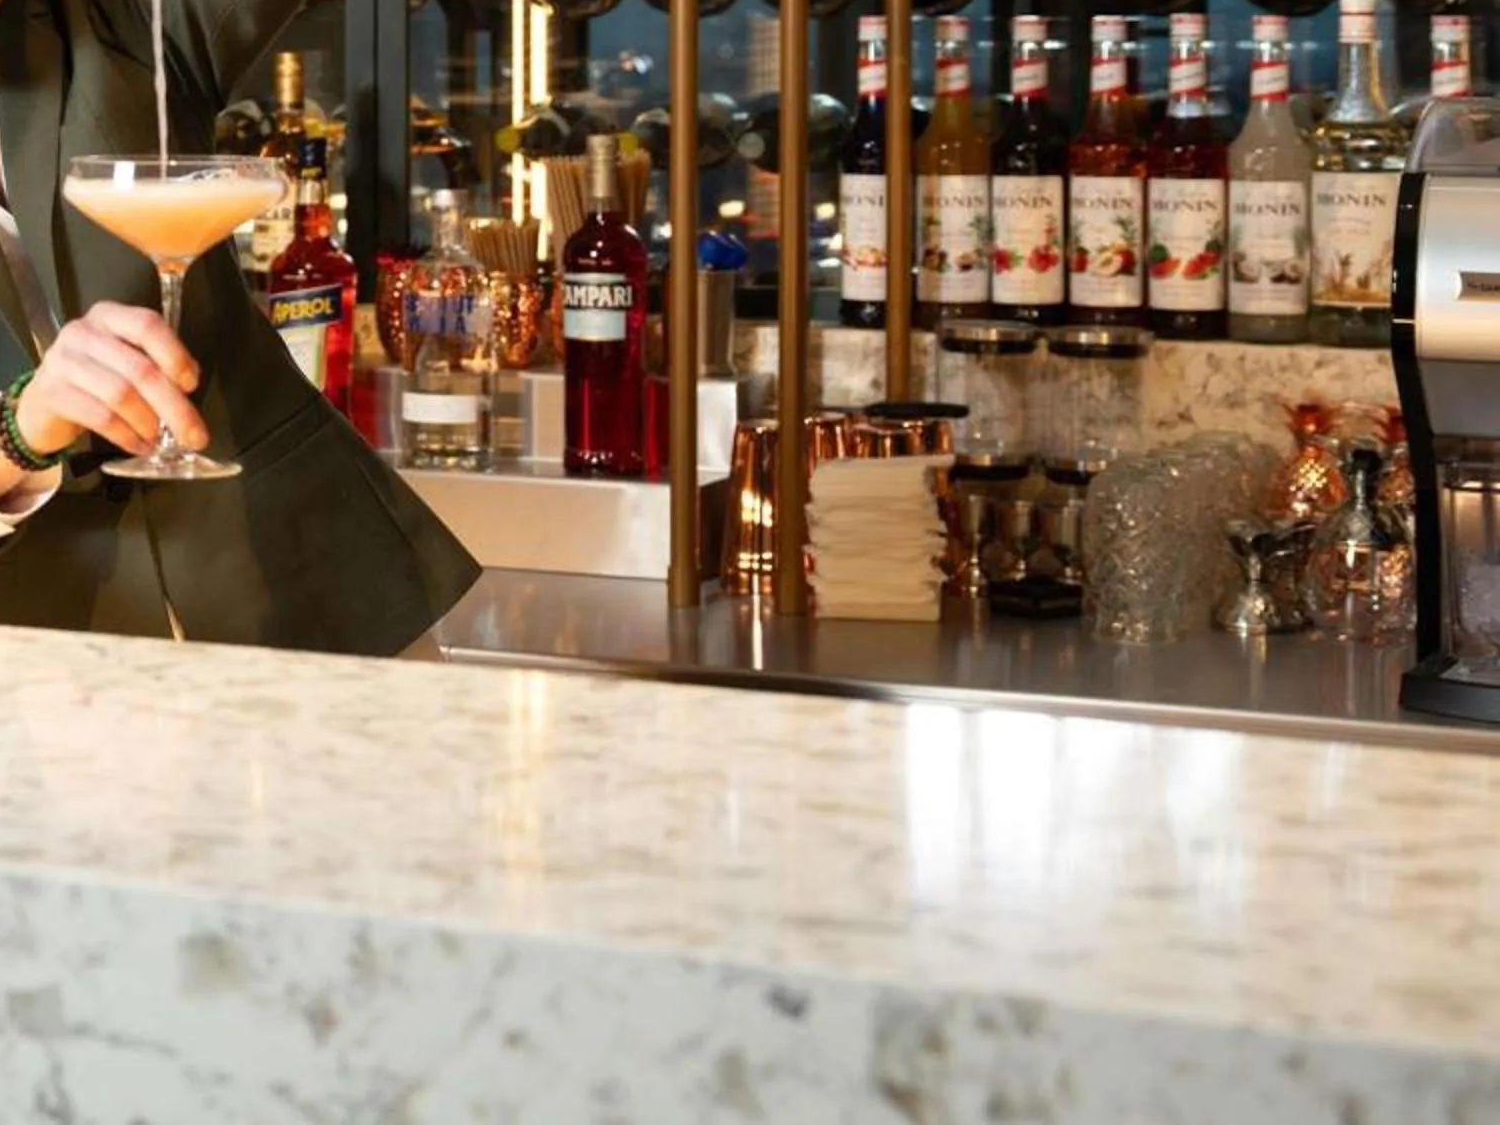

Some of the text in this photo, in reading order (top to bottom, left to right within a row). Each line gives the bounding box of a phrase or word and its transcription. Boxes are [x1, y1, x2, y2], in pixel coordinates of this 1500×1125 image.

[1152, 198, 1219, 213] MONIN
[1316, 192, 1387, 208] MONIN
[1233, 202, 1301, 216] MONIN
[563, 284, 633, 307] AMPARI
[272, 297, 334, 324] APEROL
